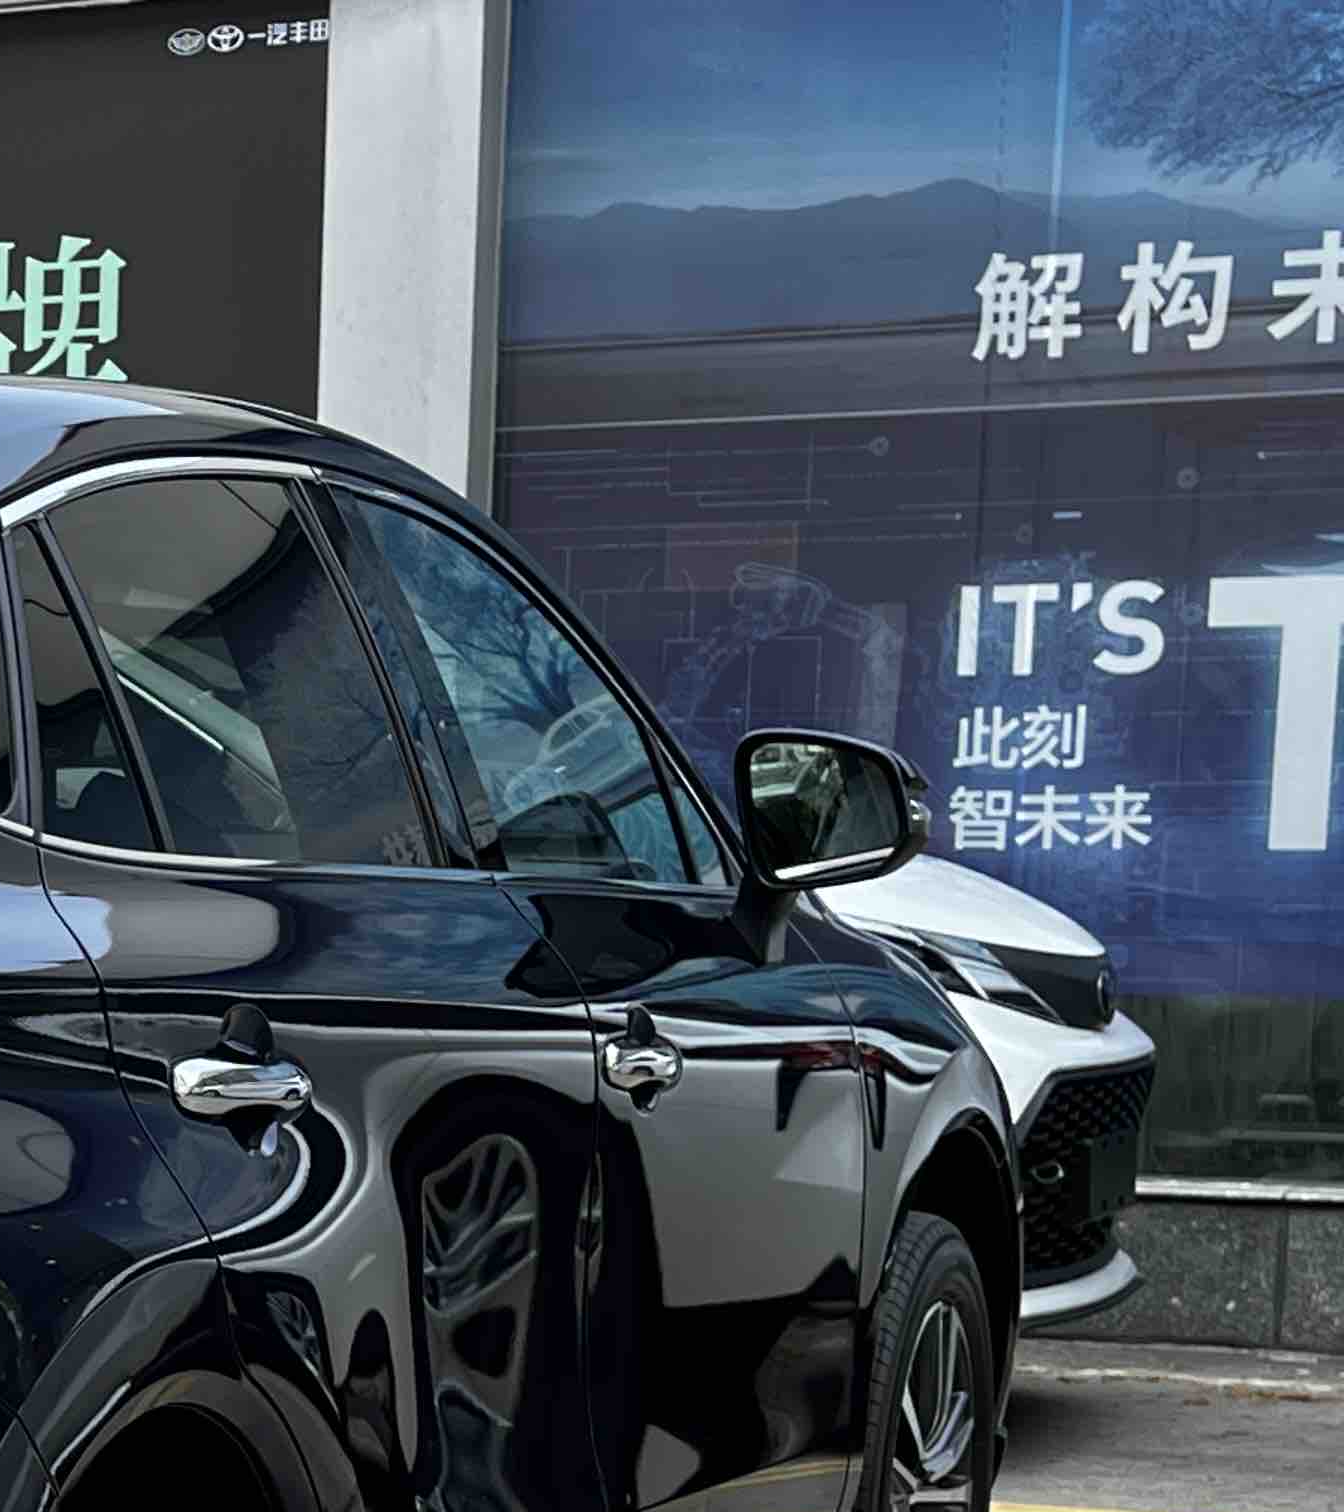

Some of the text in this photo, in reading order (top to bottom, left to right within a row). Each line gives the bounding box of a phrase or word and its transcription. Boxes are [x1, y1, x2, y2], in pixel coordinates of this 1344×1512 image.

[247, 18, 329, 46] 一汽丰田
[956, 580, 1166, 678] IT'S
[952, 704, 1088, 770] 此刻
[949, 785, 1152, 851] 智未来
